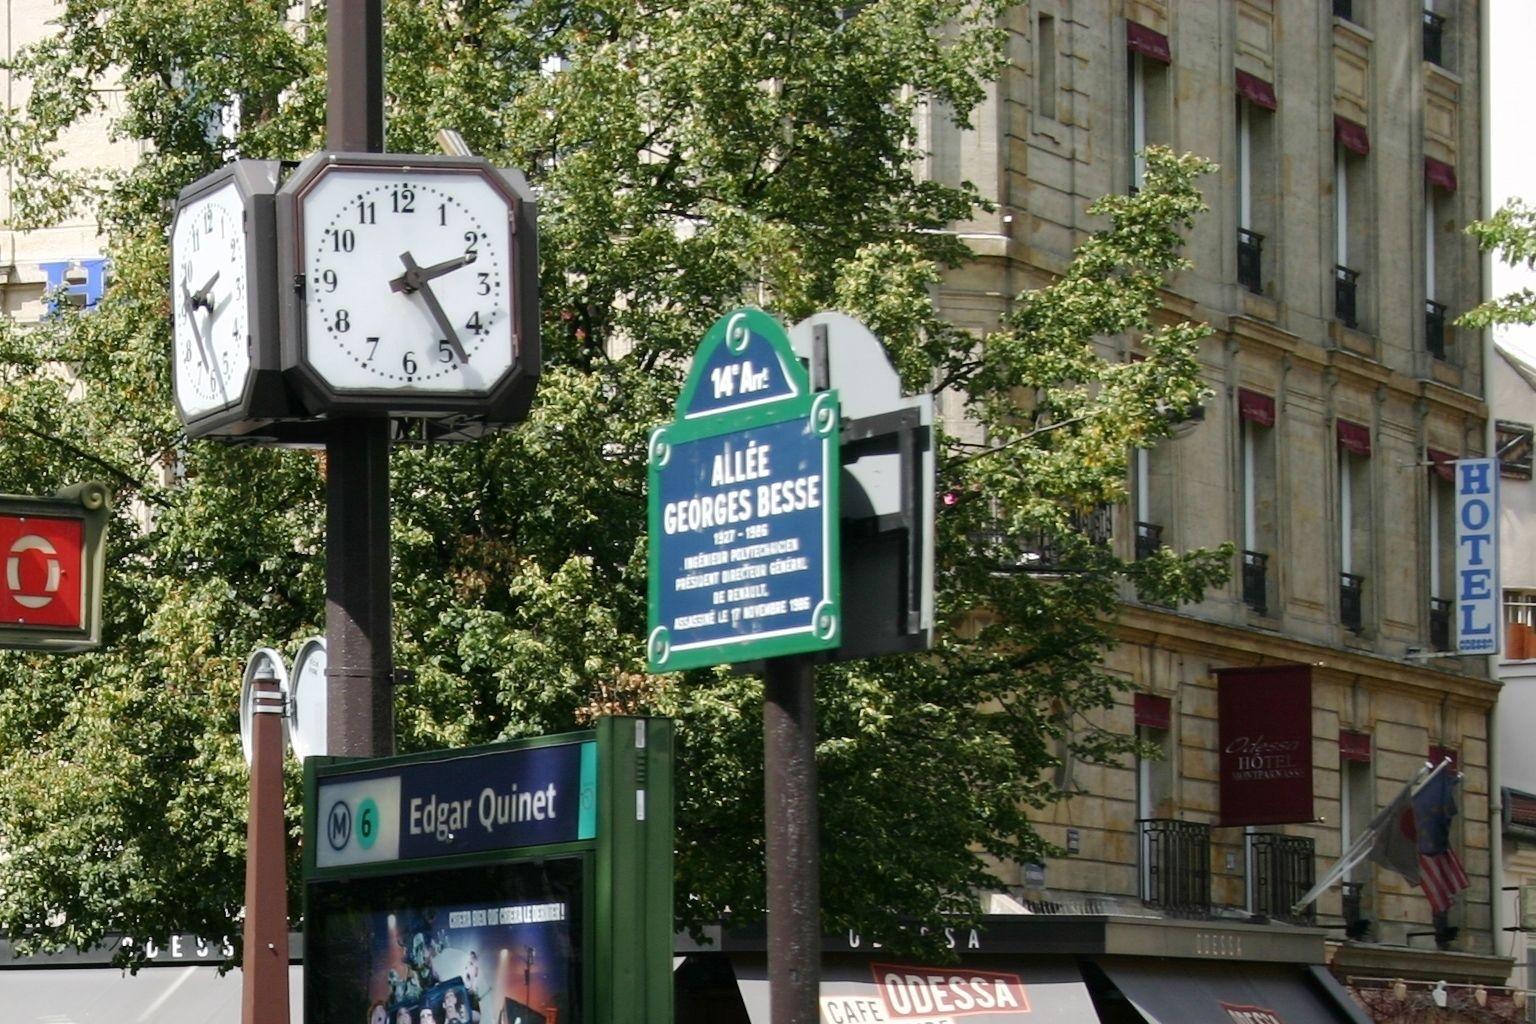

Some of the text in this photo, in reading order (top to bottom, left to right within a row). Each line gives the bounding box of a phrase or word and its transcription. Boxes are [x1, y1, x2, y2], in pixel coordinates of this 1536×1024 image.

[357, 201, 377, 225] 11
[391, 189, 415, 213] 12
[438, 204, 447, 226] 1
[331, 229, 355, 253] 10
[464, 232, 478, 254] 2
[323, 269, 337, 293] 9
[477, 273, 491, 295] 3
[335, 309, 350, 332] 8
[465, 311, 482, 335] 4
[366, 337, 380, 361] 7
[439, 340, 454, 363] 5
[402, 351, 417, 375] 6
[711, 440, 770, 487] ALLÉE
[664, 475, 820, 535] GEORGES BESSE
[1460, 464, 1491, 635] HOTEL
[713, 591, 725, 604] DE
[718, 610, 728, 623] LE
[743, 601, 787, 619] NOVEMBRE
[361, 808, 372, 838] 6
[409, 794, 472, 841] Edgar
[478, 782, 556, 832] Quinet
[884, 973, 1018, 1014] ODESSA
[827, 1000, 884, 1024] CAFE
